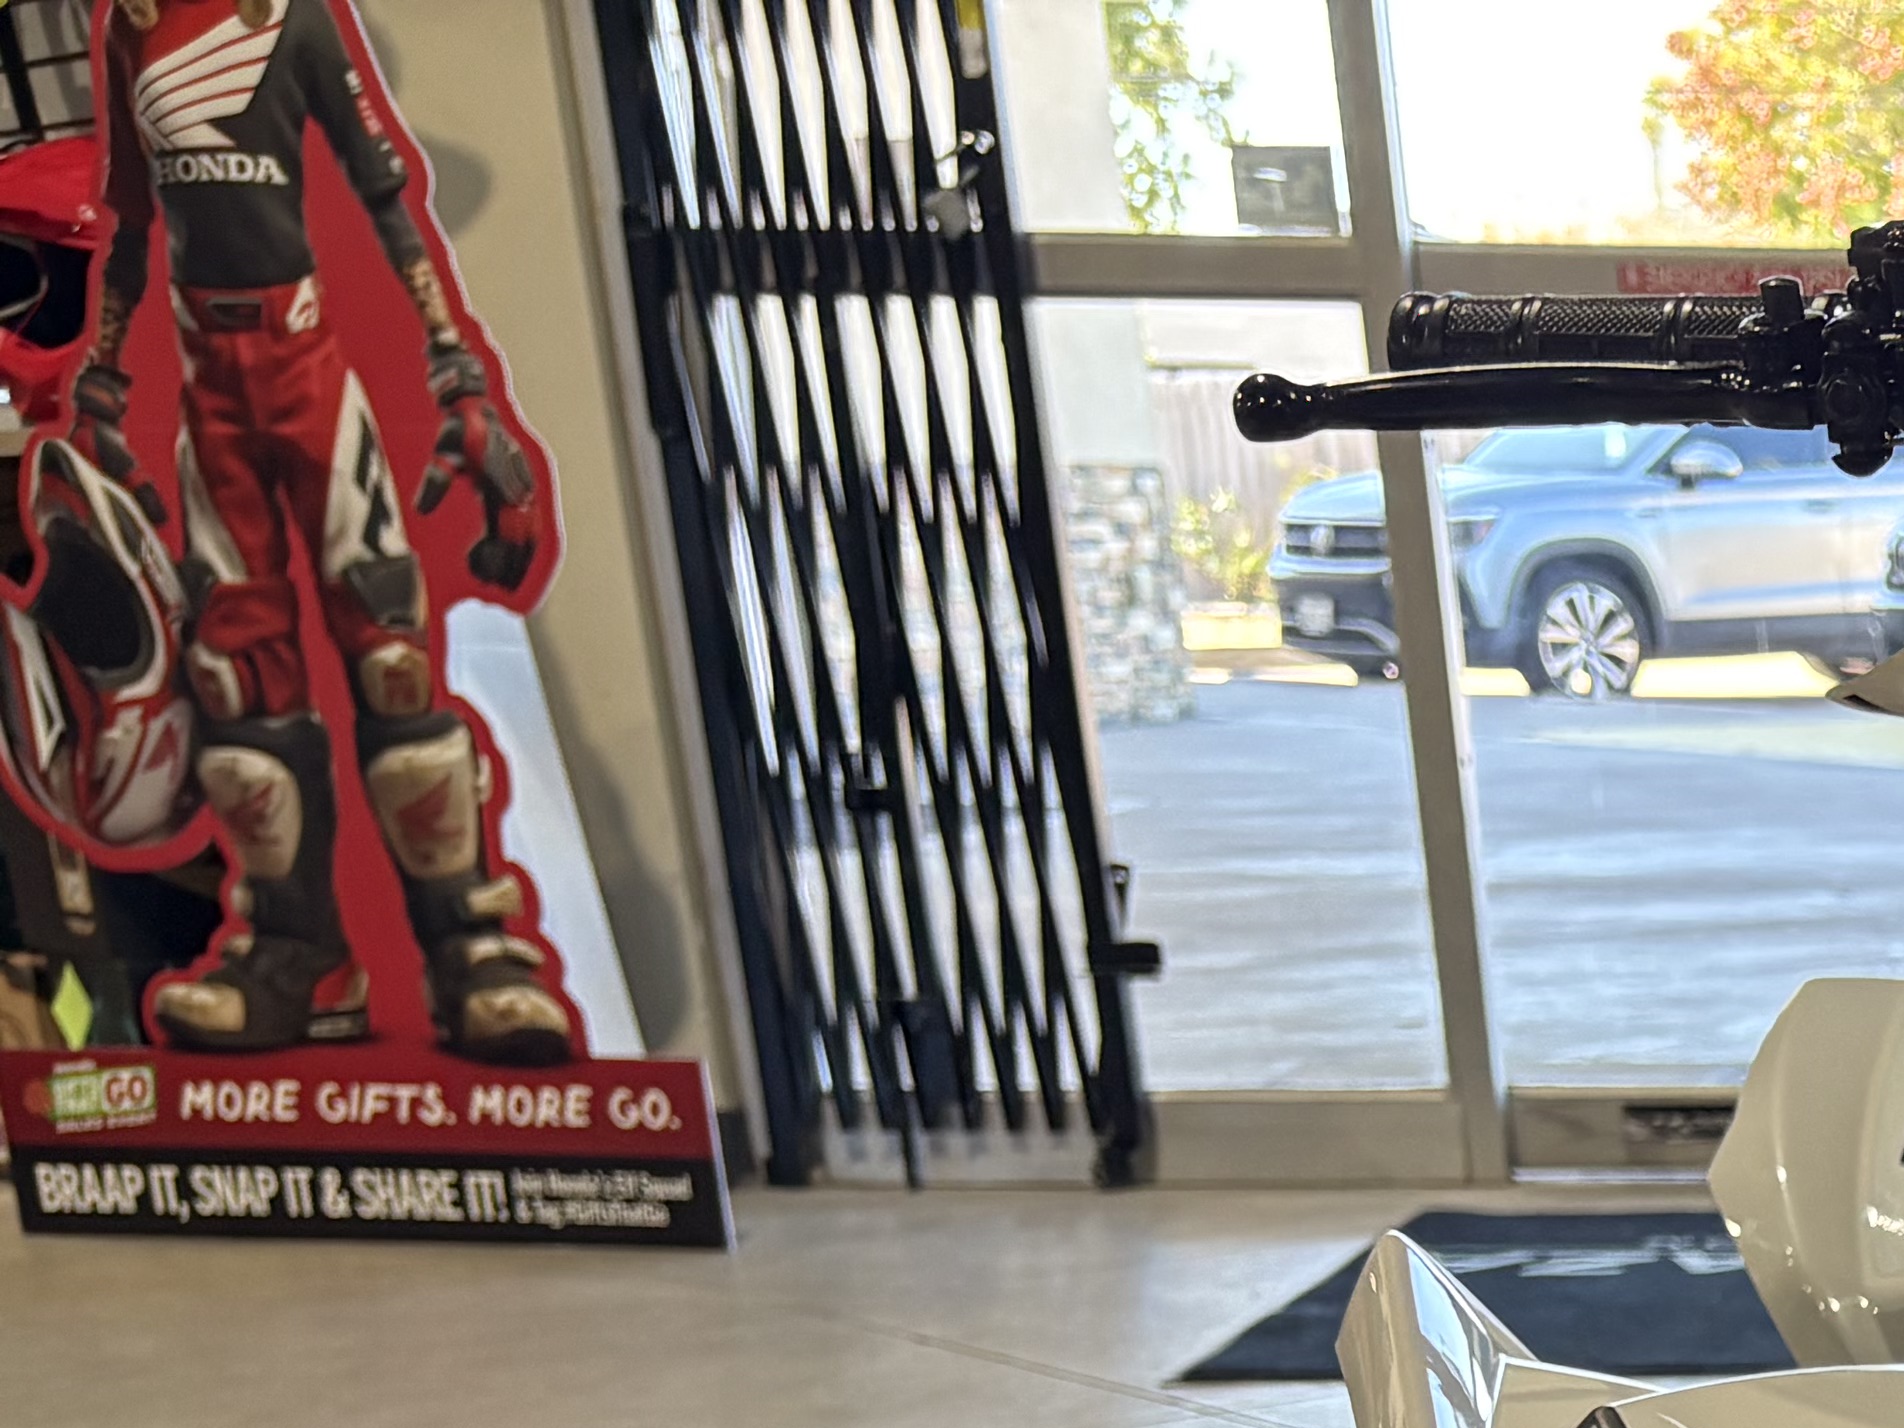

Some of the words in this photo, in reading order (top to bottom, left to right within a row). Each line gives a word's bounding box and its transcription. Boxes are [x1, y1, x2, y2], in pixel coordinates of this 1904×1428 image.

[156, 152, 290, 186] HONDA
[179, 1079, 300, 1123] MORE
[315, 1082, 457, 1127] GIFTS.
[467, 1083, 593, 1129] MORE
[608, 1086, 683, 1132] GO.
[34, 1162, 145, 1215] BRAAP
[188, 1164, 279, 1217] SNAP
[281, 1165, 314, 1219] IT
[319, 1166, 352, 1220] &
[353, 1167, 465, 1223] SHARE
